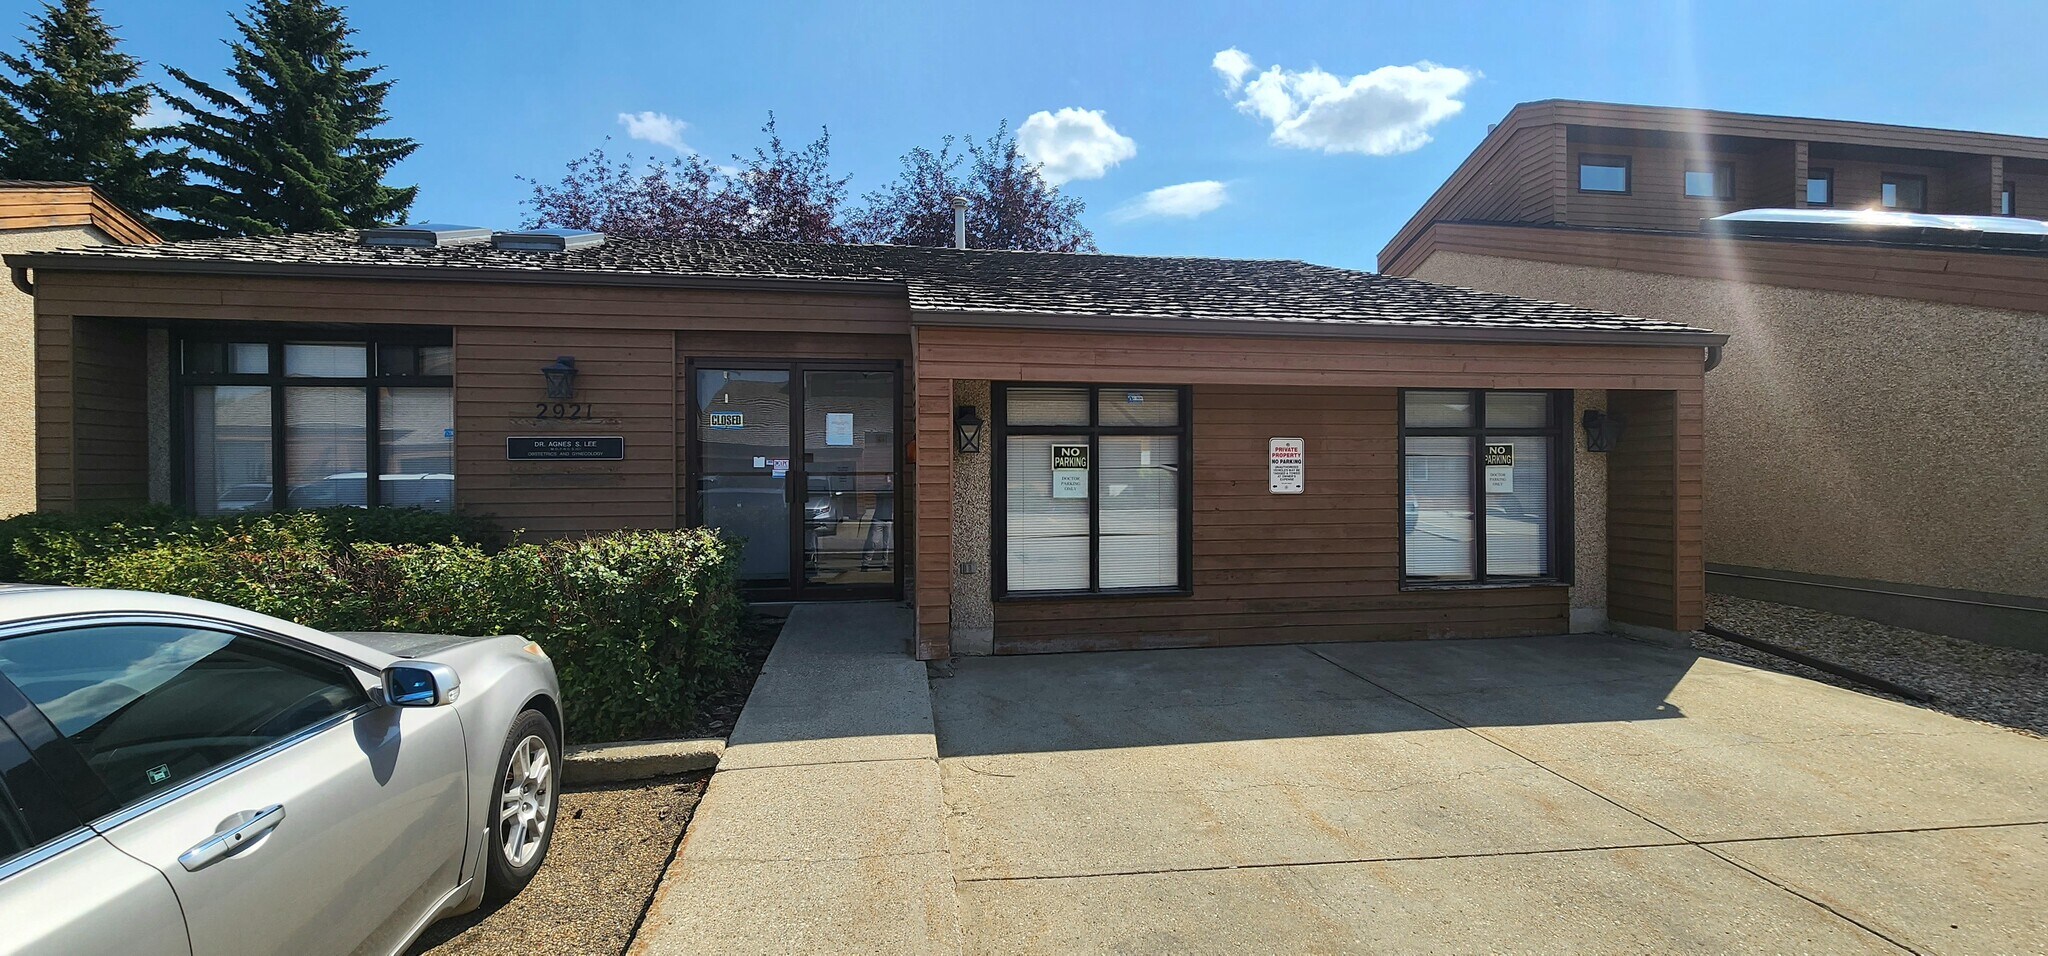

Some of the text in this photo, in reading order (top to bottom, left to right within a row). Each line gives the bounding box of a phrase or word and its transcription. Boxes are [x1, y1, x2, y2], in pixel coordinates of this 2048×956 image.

[536, 403, 592, 419] 2921
[711, 414, 742, 426] CLOSED
[1061, 448, 1080, 456] NO
[1055, 457, 1087, 467] PARKING
